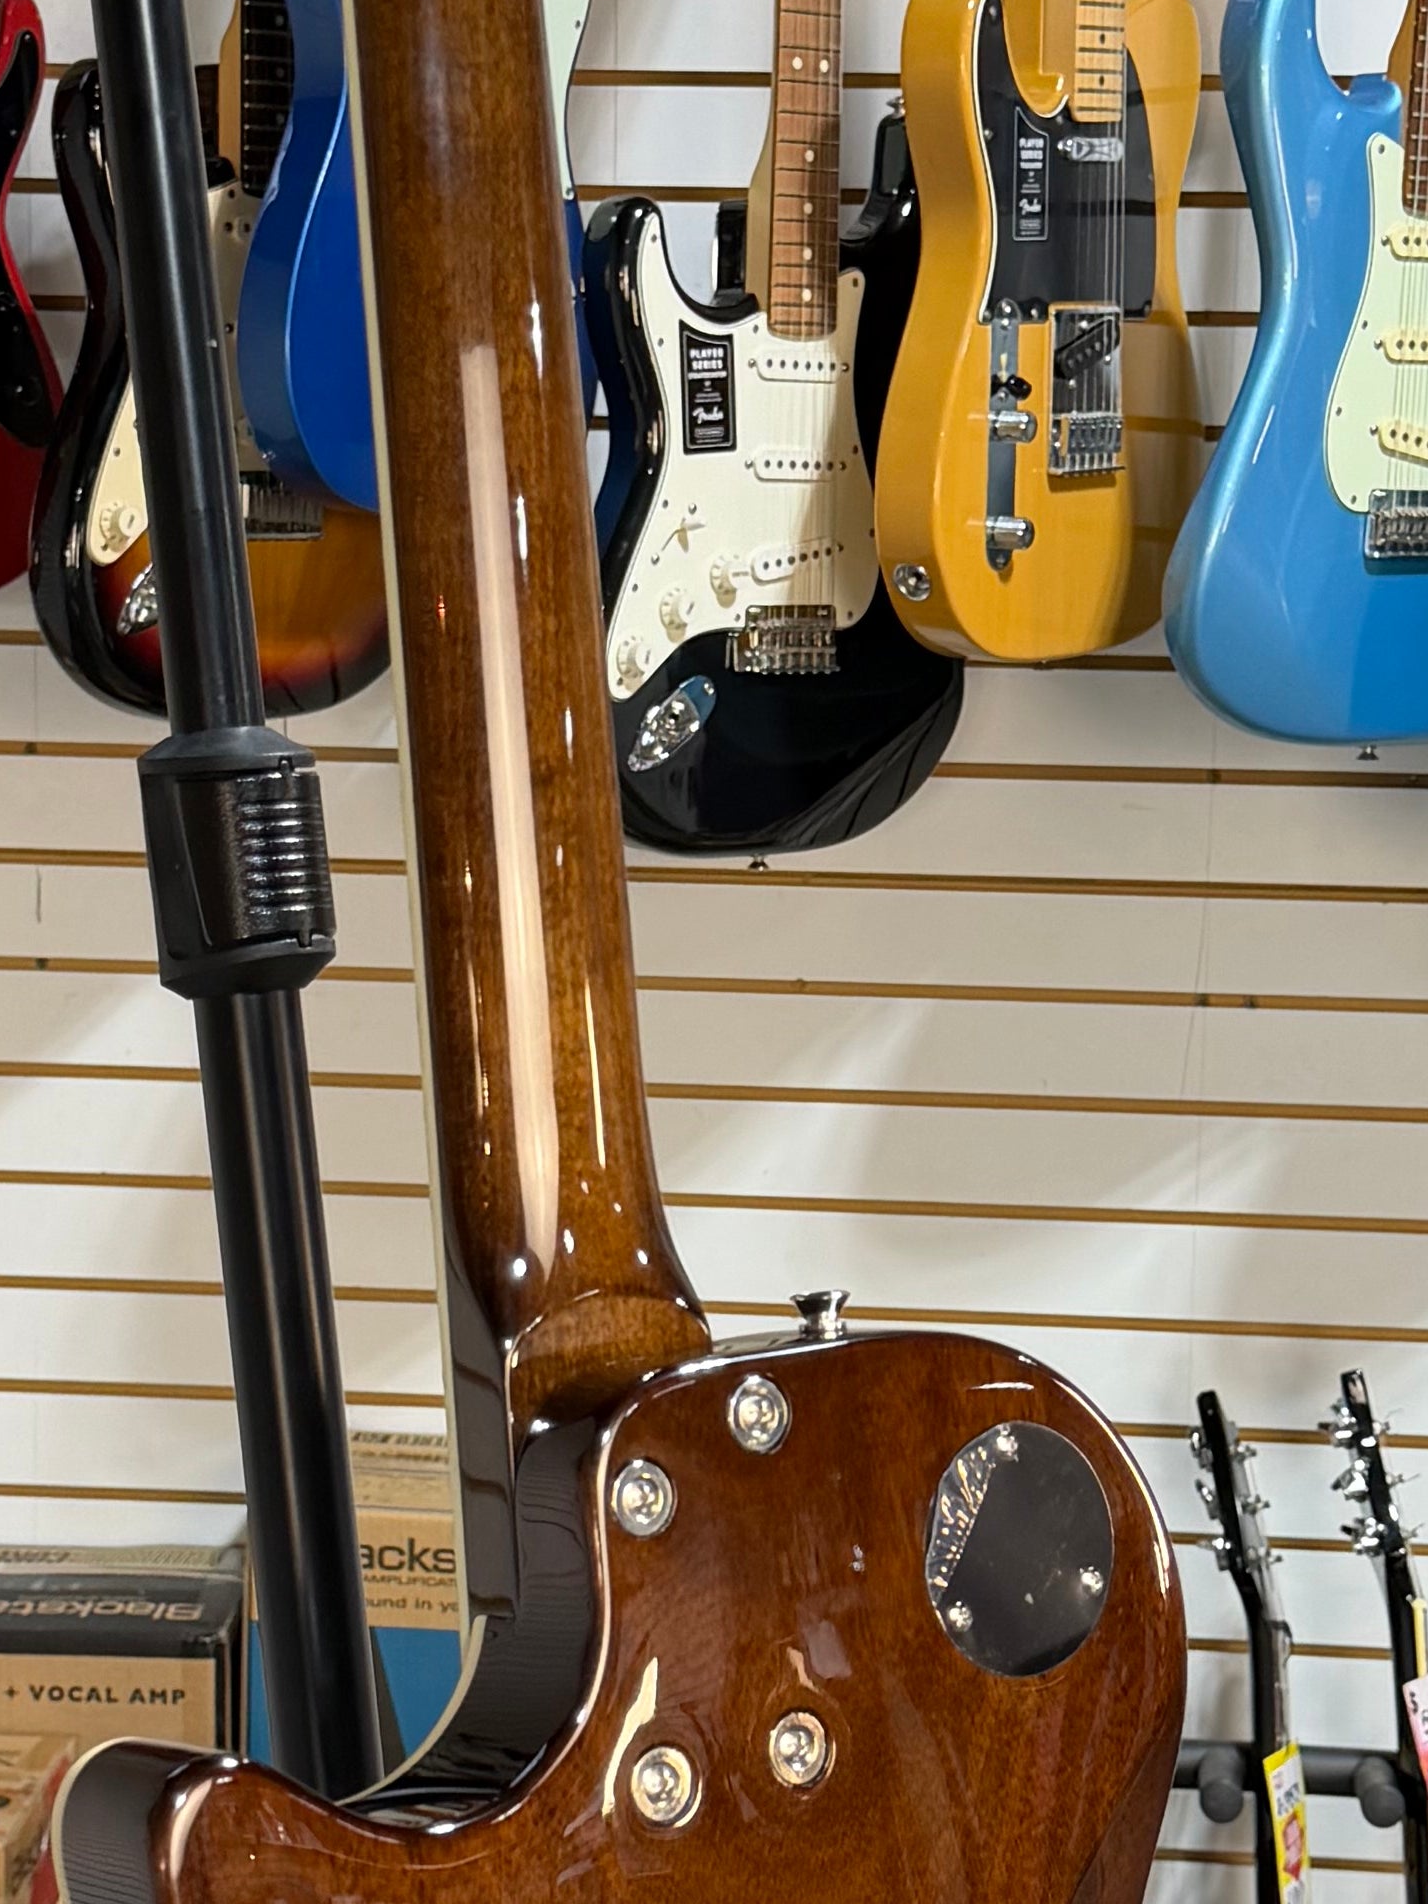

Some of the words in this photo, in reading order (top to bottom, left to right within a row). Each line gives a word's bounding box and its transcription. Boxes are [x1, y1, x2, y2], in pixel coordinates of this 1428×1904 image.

[359, 1537, 457, 1575] acks
[367, 1597, 407, 1610] und
[414, 1597, 433, 1610] in
[29, 1683, 121, 1705] VOCAL
[129, 1686, 188, 1708] AMP
